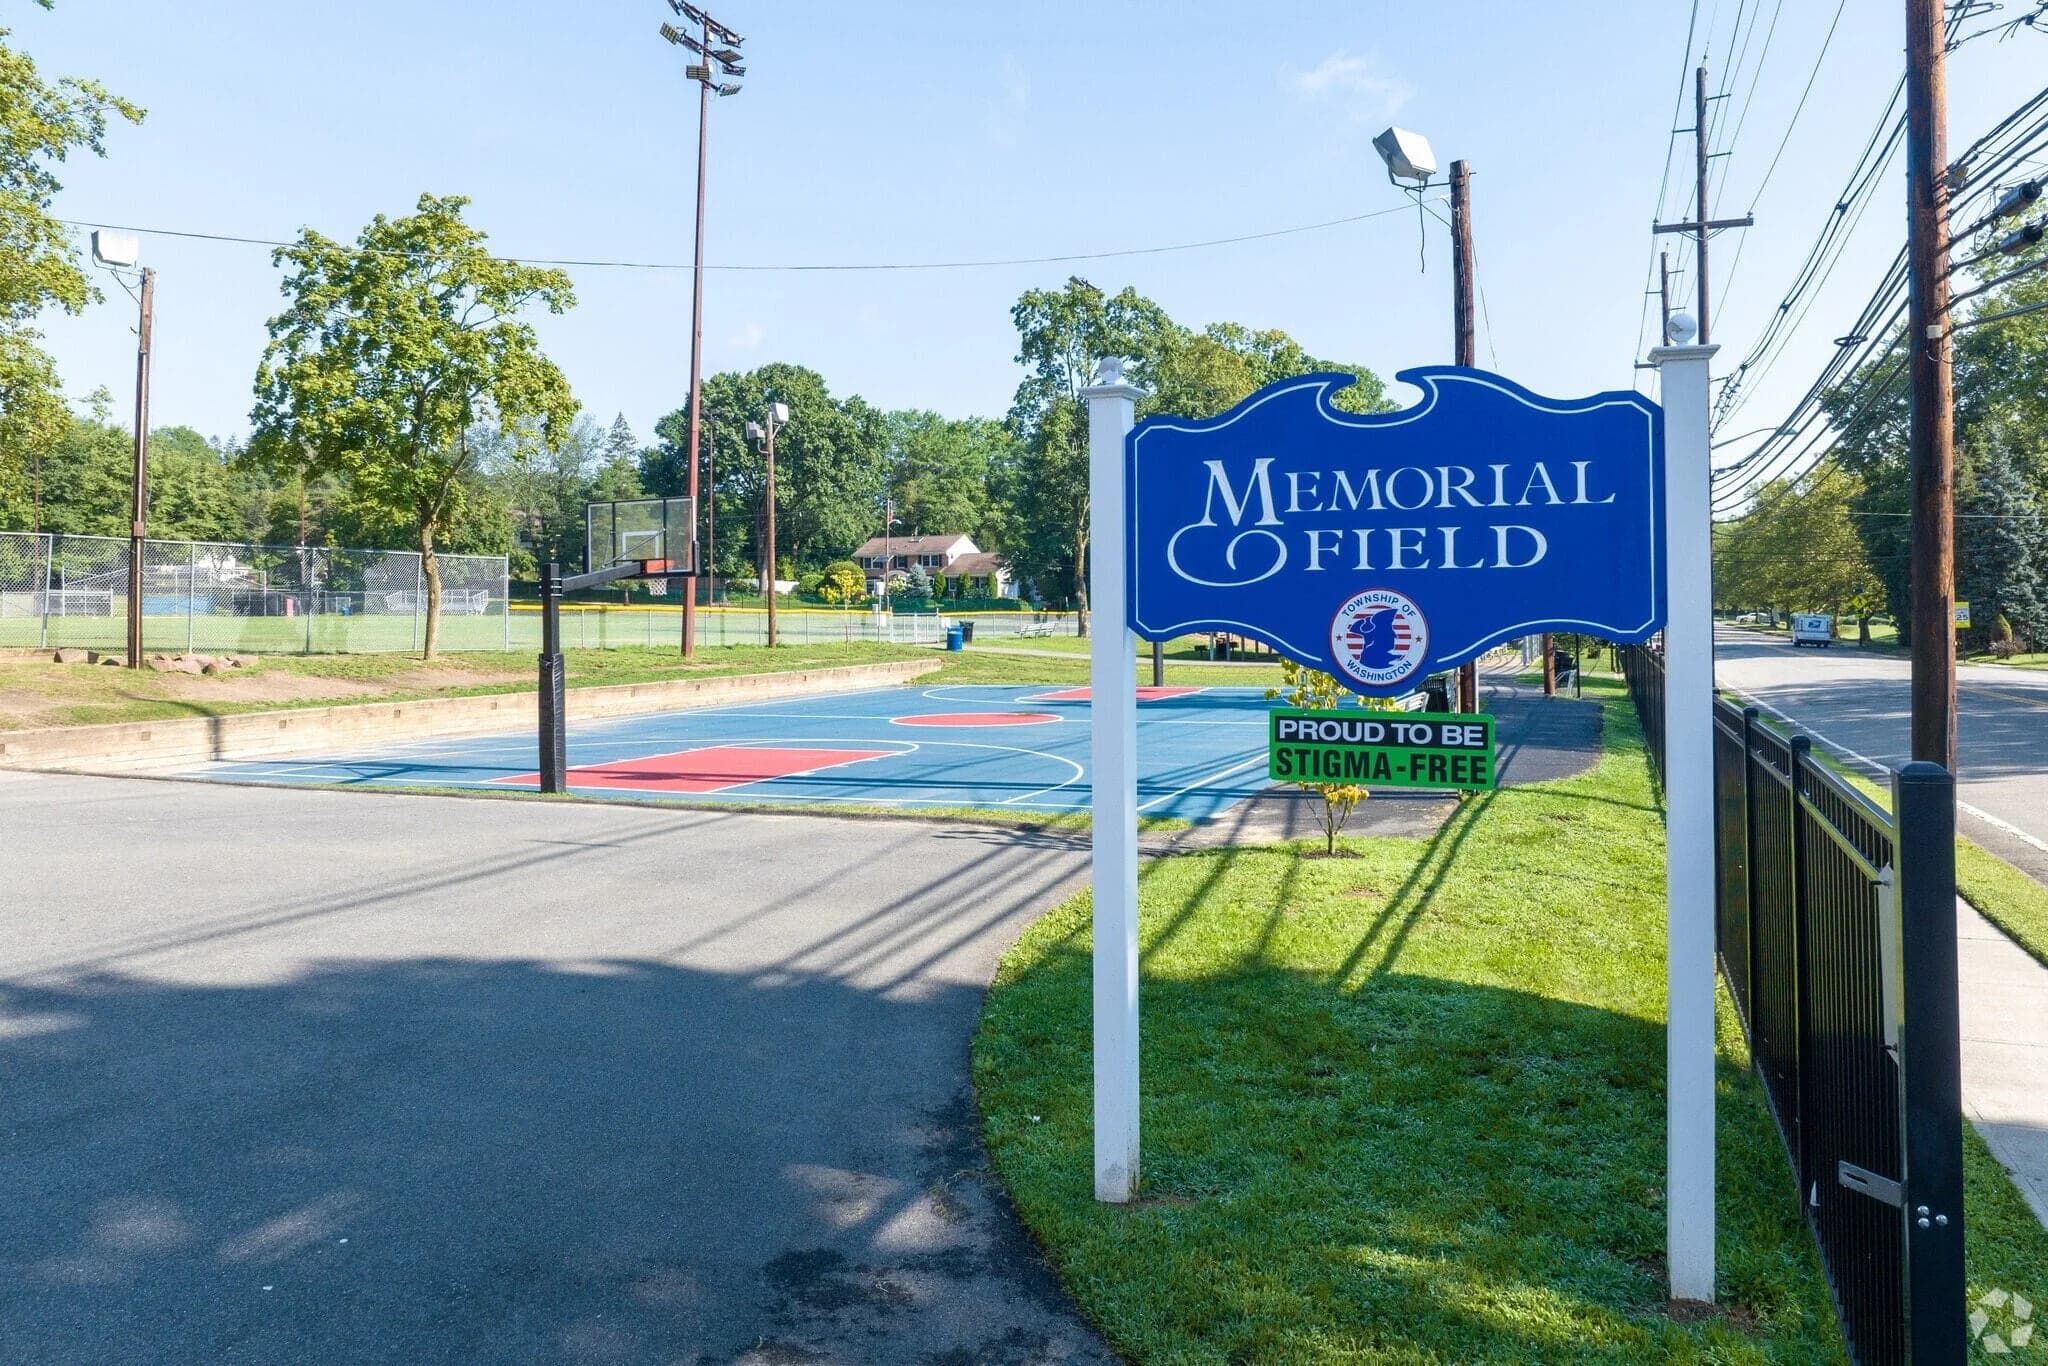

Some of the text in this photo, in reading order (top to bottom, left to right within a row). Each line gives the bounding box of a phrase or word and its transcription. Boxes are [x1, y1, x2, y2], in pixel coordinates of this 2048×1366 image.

[1200, 457, 1616, 527] MEMORIAL
[1303, 524, 1548, 571] FIELD
[1342, 593, 1417, 618] TOWNSHIP OF
[1346, 660, 1413, 681] WASHINGTON
[1278, 719, 1484, 747] PROUD TO BE
[1276, 747, 1488, 785] STIGMA-FREE
